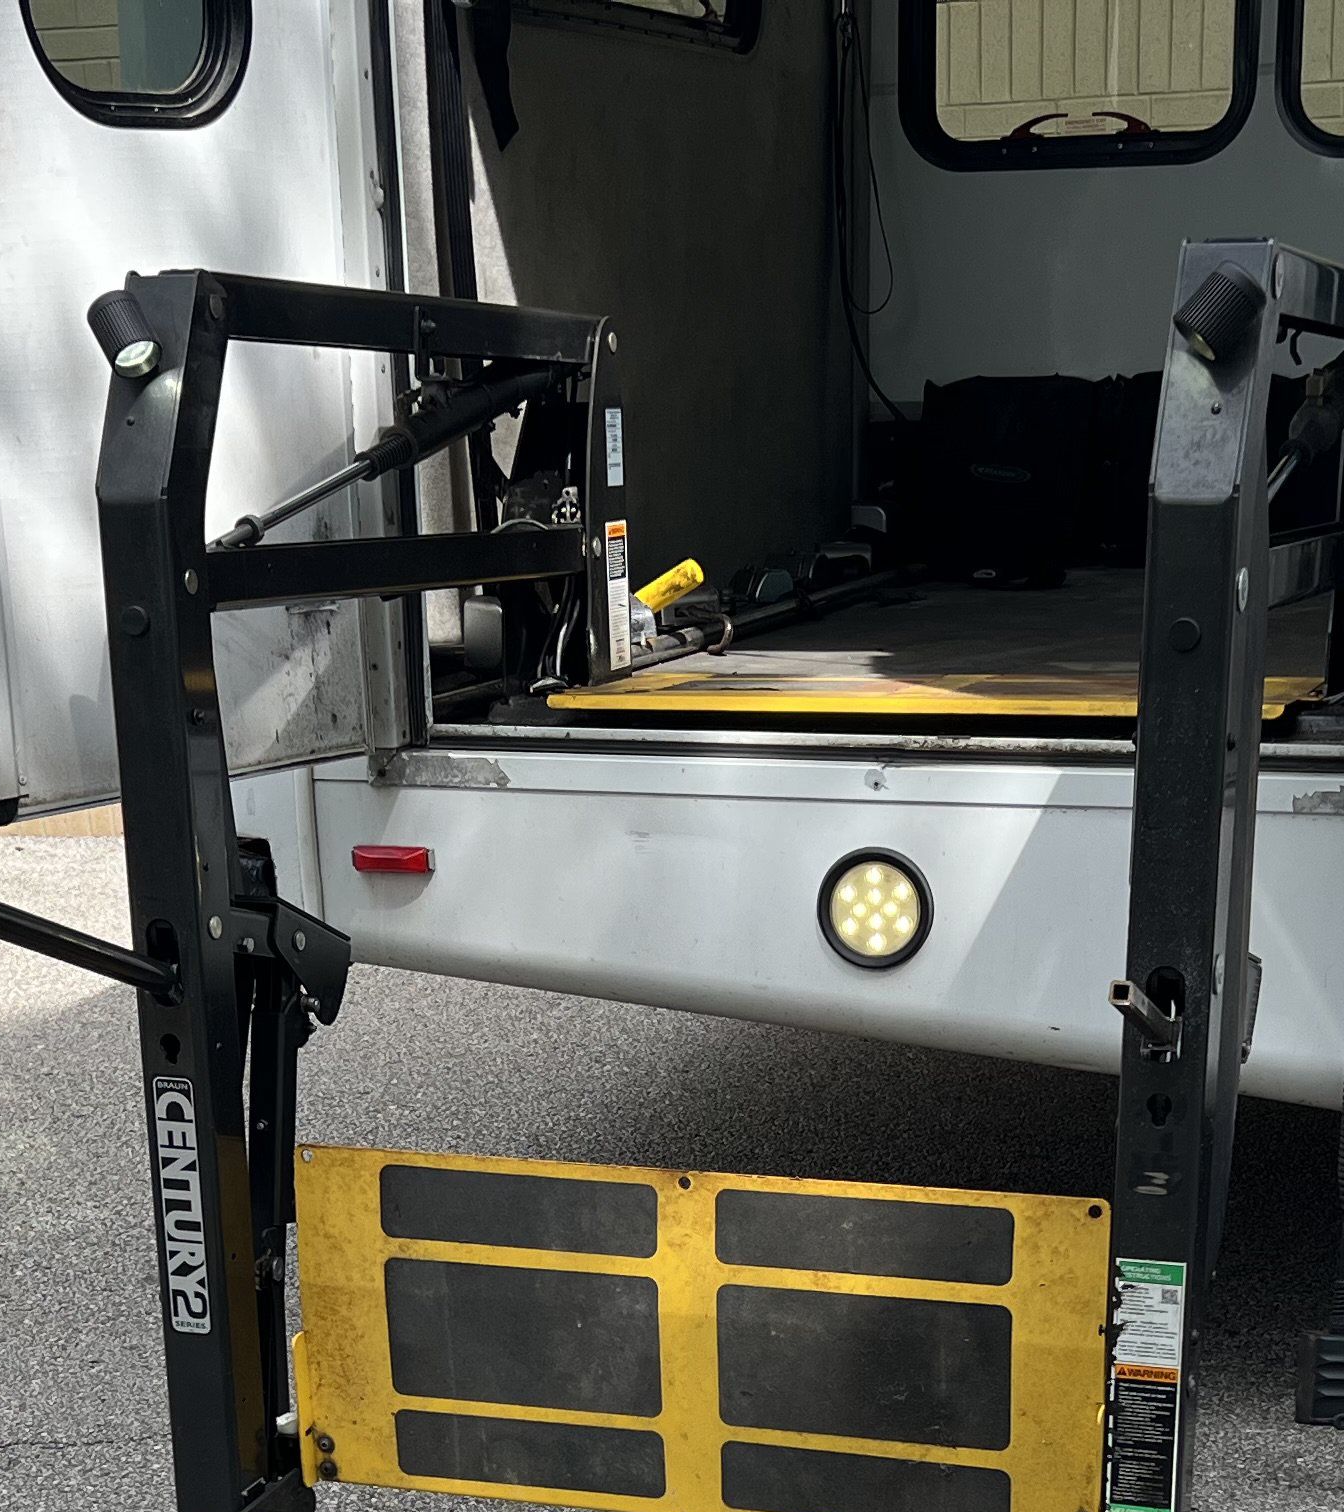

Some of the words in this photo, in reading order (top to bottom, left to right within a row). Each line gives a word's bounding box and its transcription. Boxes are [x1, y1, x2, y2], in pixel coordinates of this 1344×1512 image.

[158, 1081, 189, 1091] BRAUN
[174, 1319, 207, 1330] SERIES
[1127, 1368, 1177, 1381] WARNING
